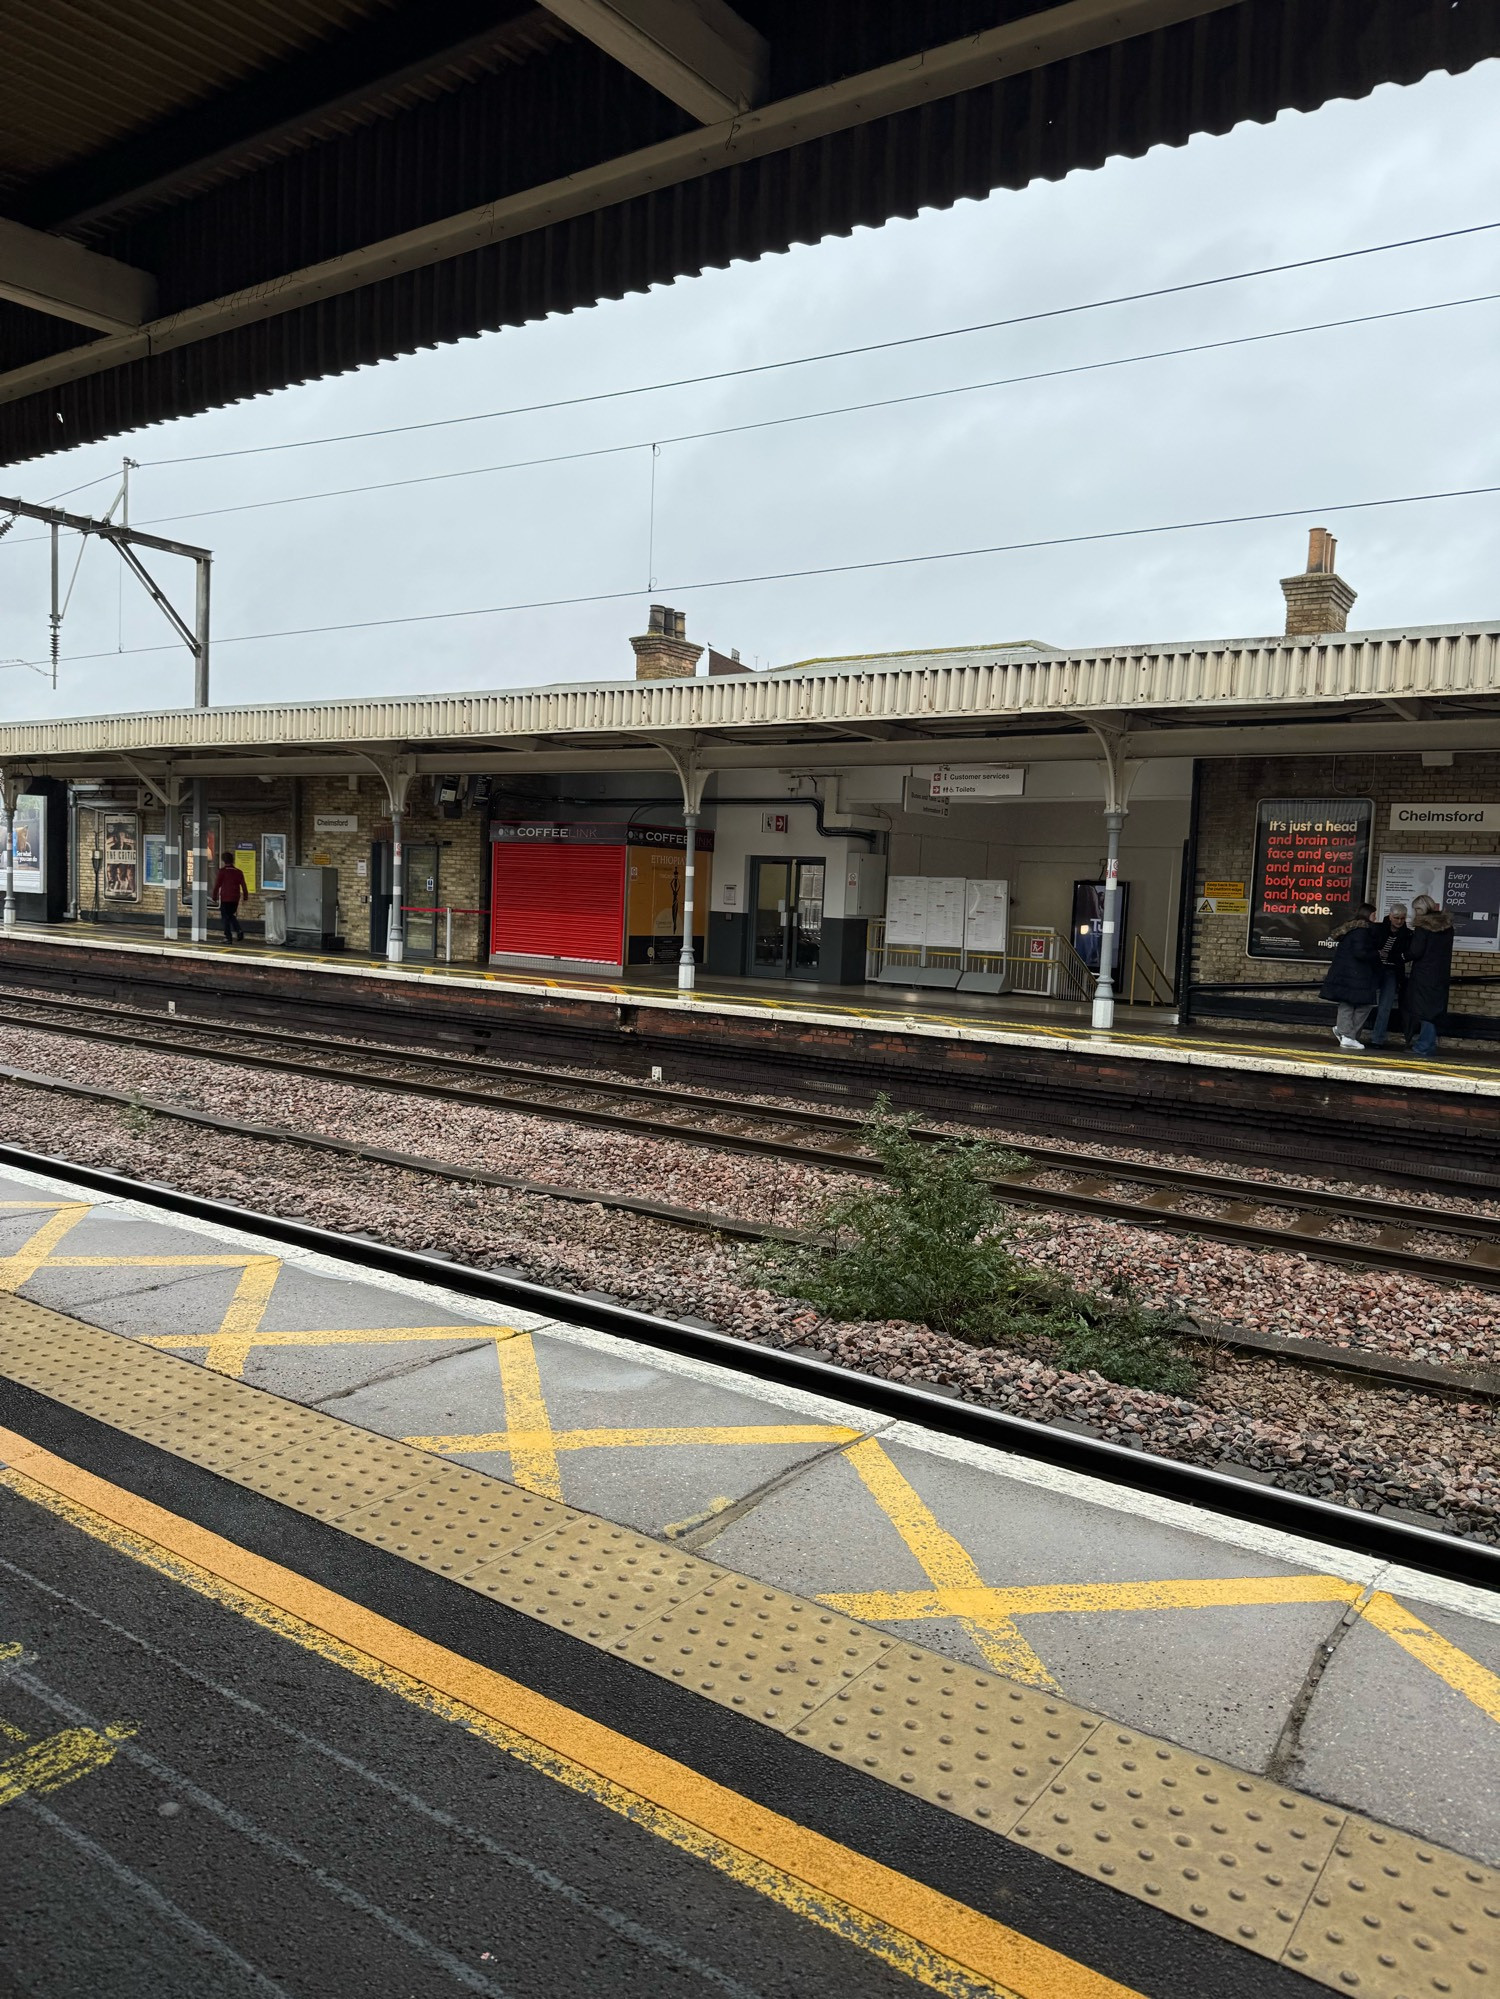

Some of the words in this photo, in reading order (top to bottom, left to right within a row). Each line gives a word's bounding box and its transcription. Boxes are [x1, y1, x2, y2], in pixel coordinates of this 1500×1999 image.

[950, 773, 981, 781] Customer
[983, 772, 1010, 780] services
[144, 792, 154, 807] 2
[1398, 810, 1484, 822] Chelmsford
[317, 818, 349, 827] Chelmsford
[1270, 820, 1287, 831] It's
[1289, 820, 1312, 833] just
[1314, 822, 1323, 832] a
[1325, 820, 1358, 832] head
[1268, 834, 1292, 845] and
[1295, 834, 1328, 846] brain
[1331, 835, 1357, 846] and
[1267, 847, 1294, 859] face
[1297, 848, 1321, 860] and
[1324, 853, 1354, 862] eyes
[651, 855, 687, 867] ETHIOPIA
[1266, 861, 1290, 873] and
[1293, 862, 1325, 873] mind
[1328, 863, 1353, 874] and
[1265, 875, 1295, 888] body
[1298, 876, 1323, 887] and
[1326, 877, 1352, 888] soul
[1448, 871, 1473, 881] Every
[1447, 881, 1470, 889] train.
[1263, 889, 1288, 901] and
[1291, 890, 1323, 903] hope
[1325, 891, 1350, 902] and
[1446, 889, 1467, 897] One
[1445, 898, 1467, 906] app.
[1263, 901, 1298, 914] heart
[1300, 903, 1333, 916] ache.
